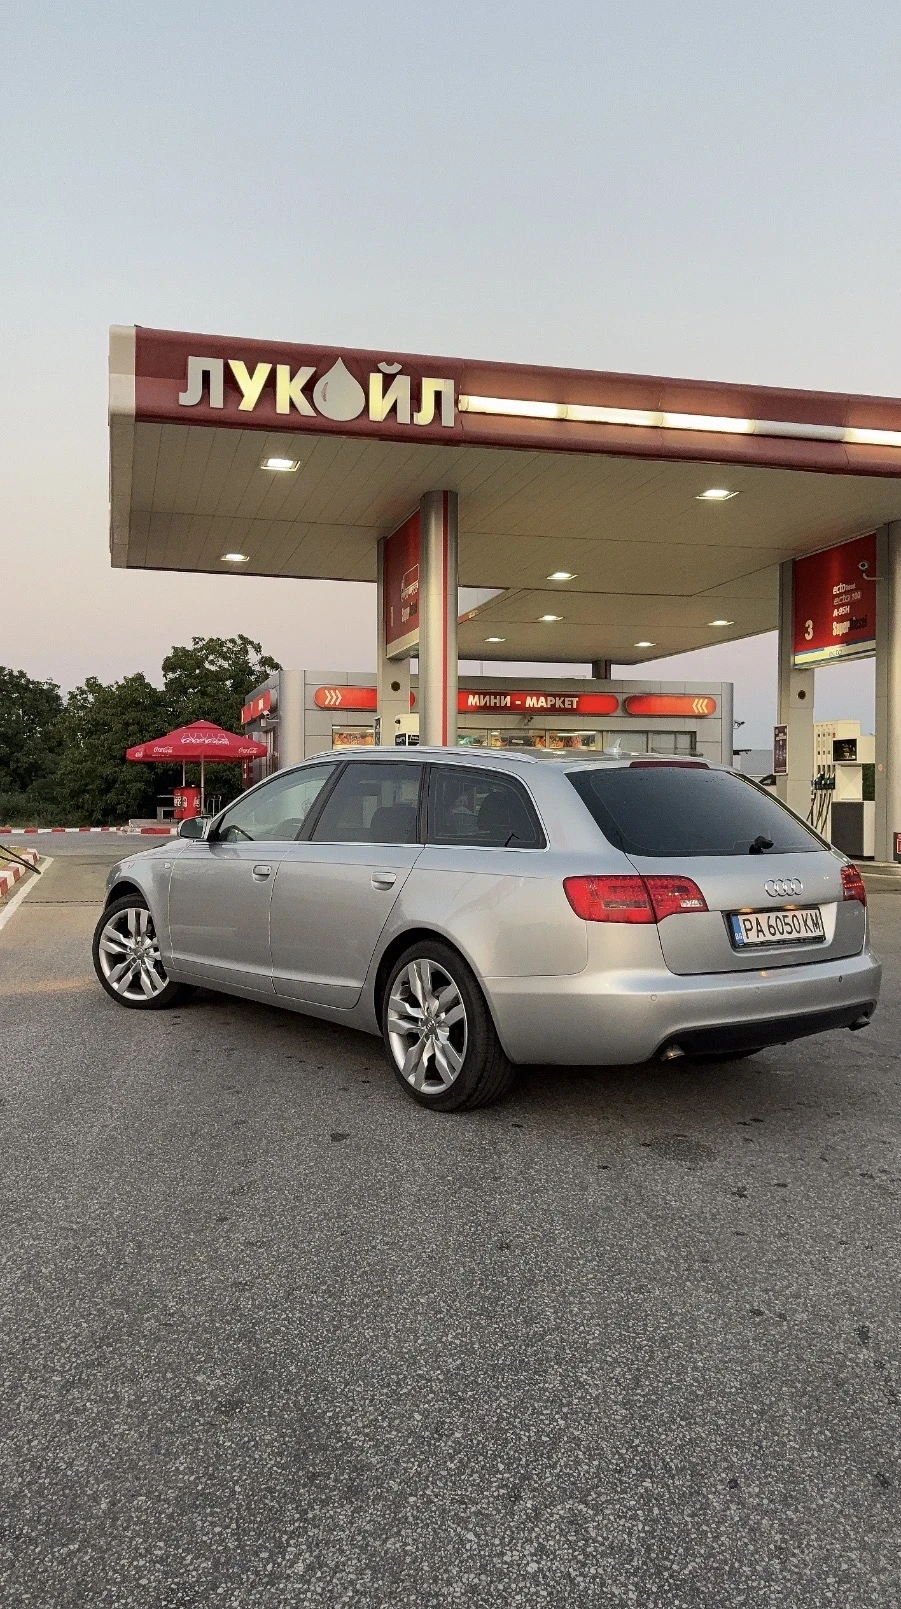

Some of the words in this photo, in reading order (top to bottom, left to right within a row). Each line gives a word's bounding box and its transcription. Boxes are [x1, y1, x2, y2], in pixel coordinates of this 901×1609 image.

[833, 593, 850, 606] ecto
[804, 619, 814, 640] 3
[467, 694, 511, 707] МИНИ
[525, 696, 579, 709] МАРКЕТ
[742, 916, 766, 940] PA
[766, 913, 801, 937] 6050
[800, 911, 822, 934] KM
